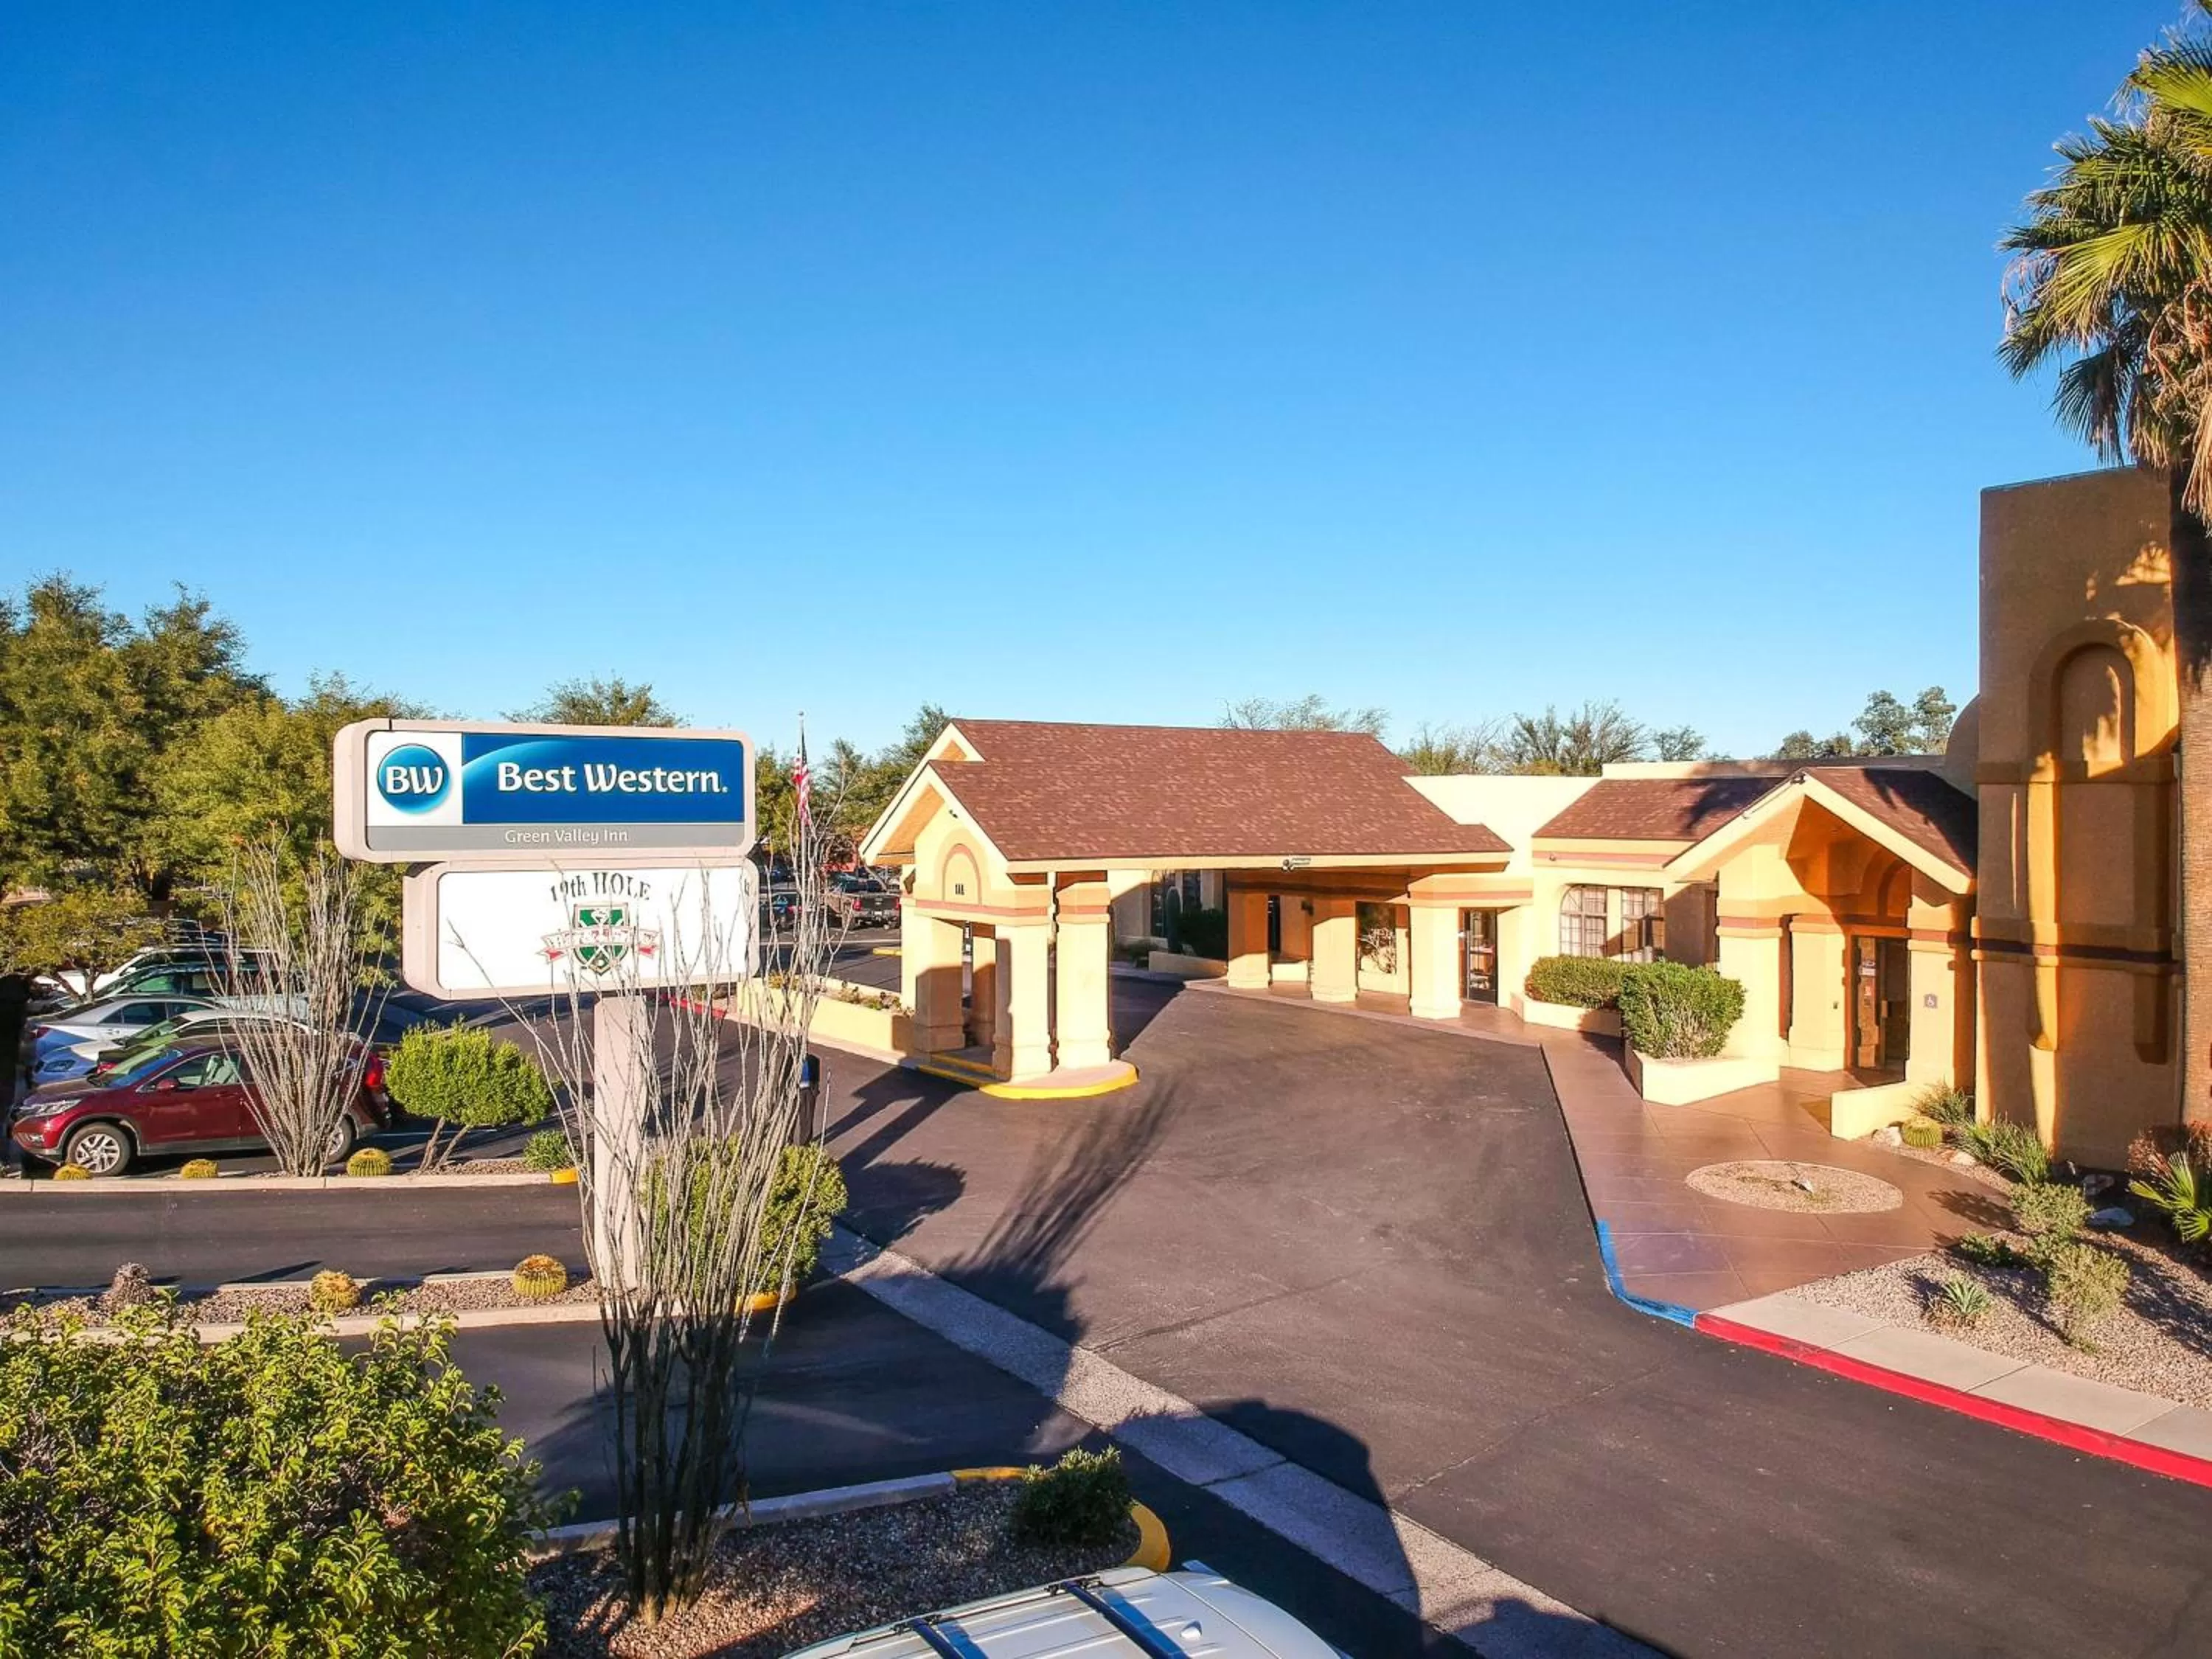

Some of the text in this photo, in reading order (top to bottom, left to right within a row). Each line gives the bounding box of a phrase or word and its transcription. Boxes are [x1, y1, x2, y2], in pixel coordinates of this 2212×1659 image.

[386, 766, 443, 794] BW
[498, 762, 577, 792] Best
[505, 830, 628, 844] Green Valley Inn
[550, 872, 650, 902] 19th HOLE
